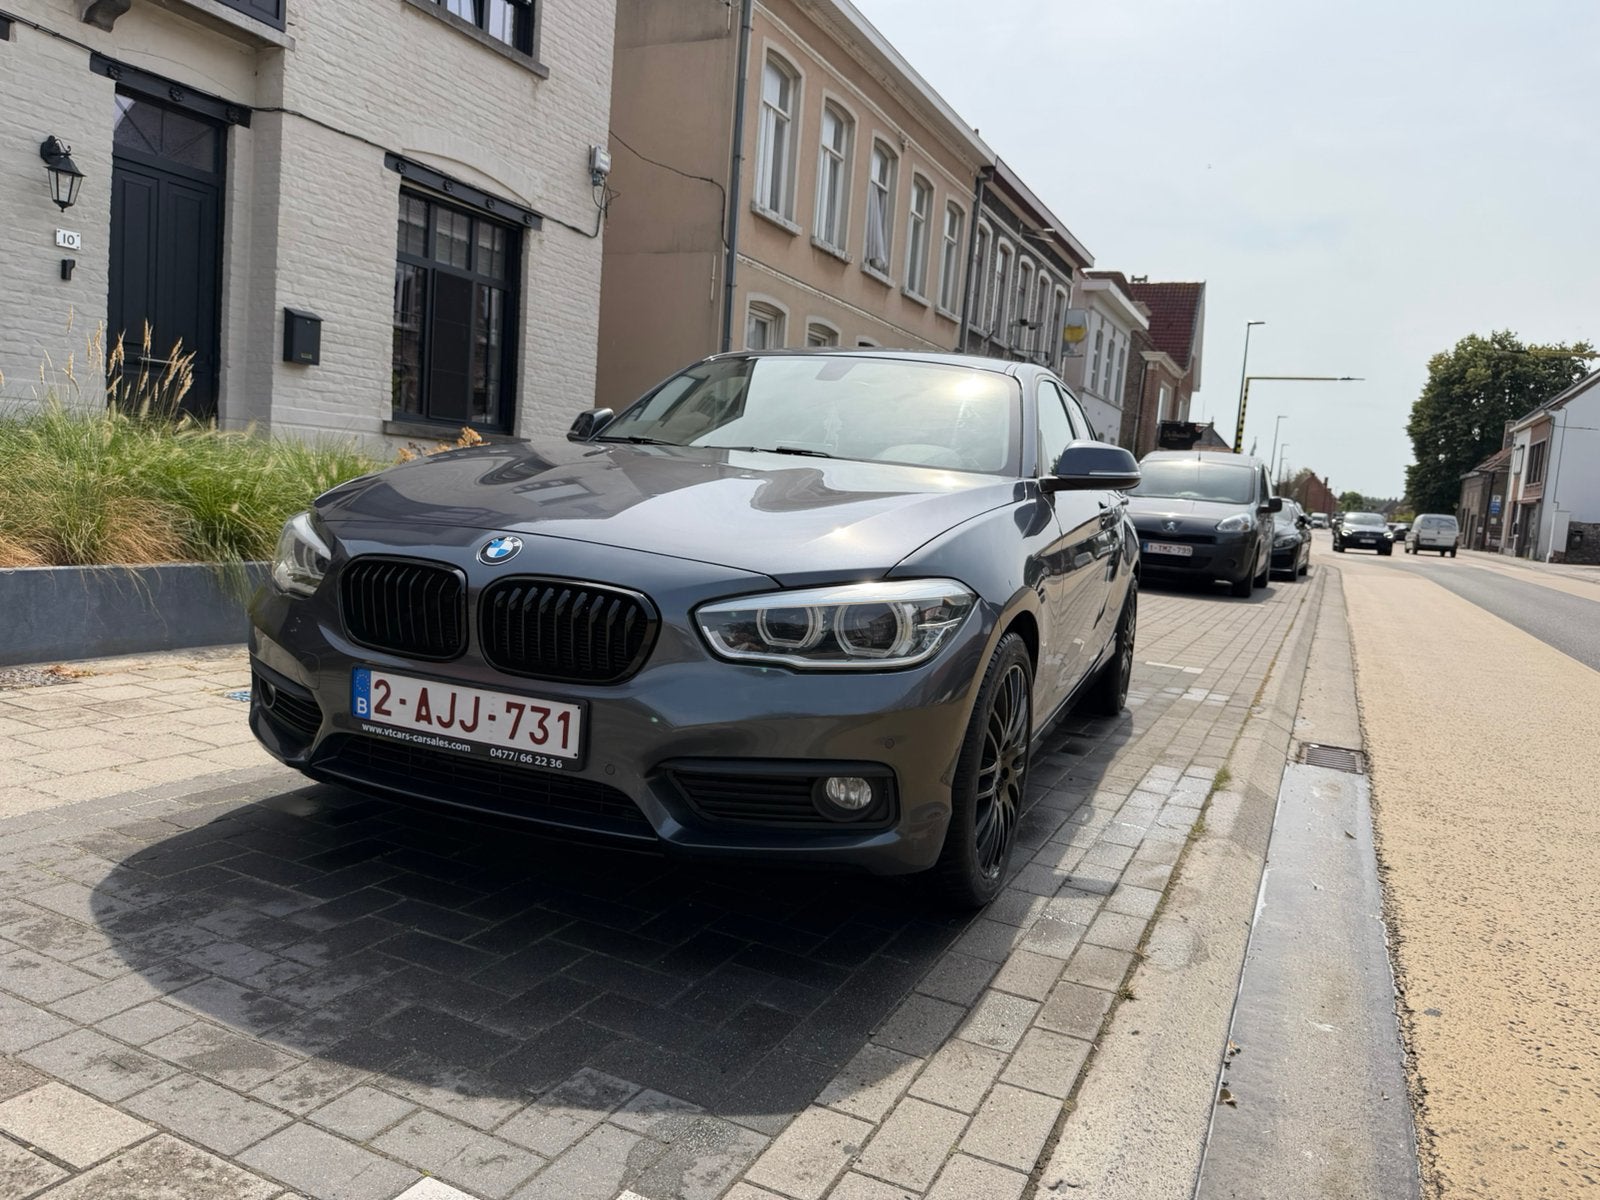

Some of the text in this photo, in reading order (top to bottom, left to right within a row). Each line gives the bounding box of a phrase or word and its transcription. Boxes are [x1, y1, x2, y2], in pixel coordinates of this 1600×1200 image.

[63, 233, 75, 246] 10
[357, 697, 368, 714] B
[373, 679, 571, 749] 2-AJJ-731
[361, 723, 471, 752] www.vtcars-carsales.com
[519, 753, 533, 764] 66
[534, 756, 548, 767] 22
[549, 758, 563, 769] 36
